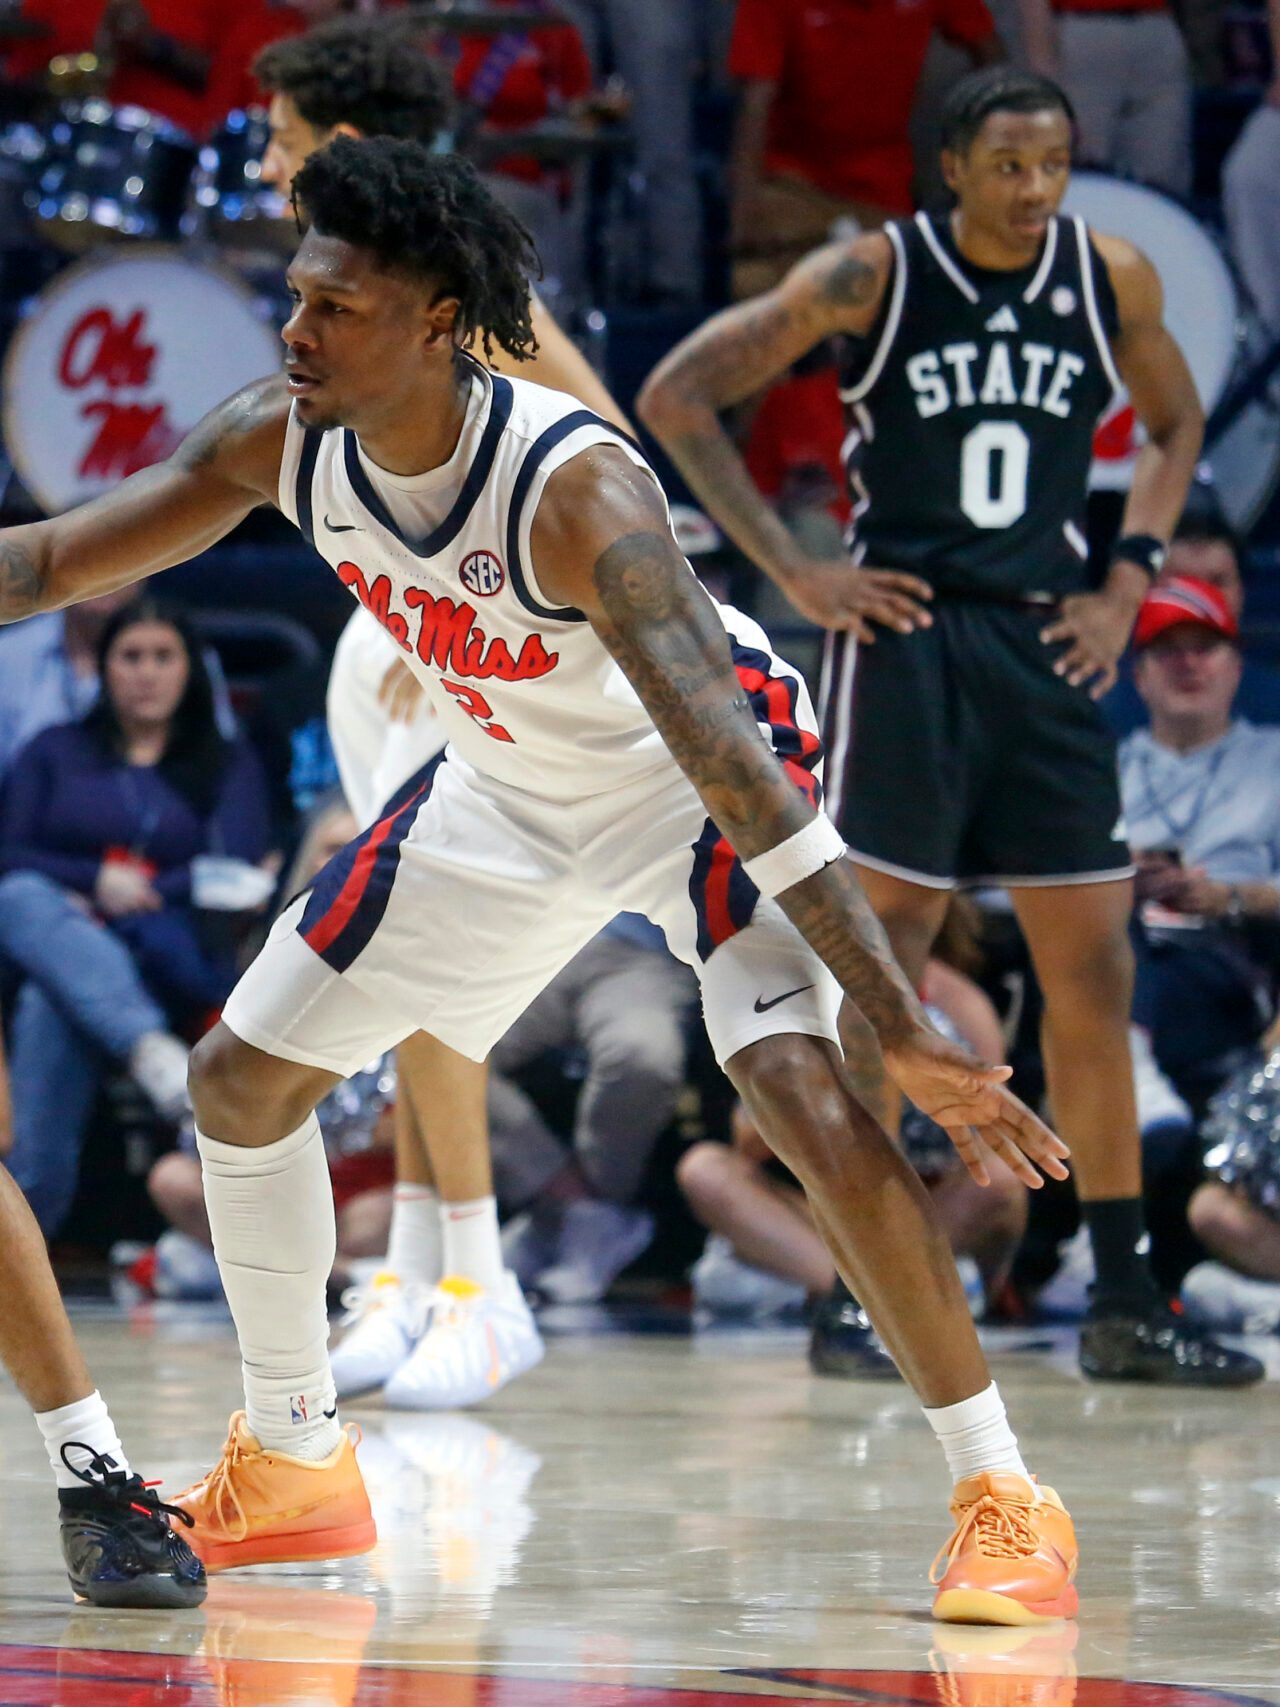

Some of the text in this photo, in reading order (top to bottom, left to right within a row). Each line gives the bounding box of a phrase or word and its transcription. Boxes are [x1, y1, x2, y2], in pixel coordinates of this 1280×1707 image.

[58, 306, 158, 391] Ole
[906, 342, 1085, 418] STATE
[961, 421, 1030, 529] 0
[462, 554, 502, 594] SEC
[403, 586, 560, 682] Miss
[439, 677, 517, 745] 2
